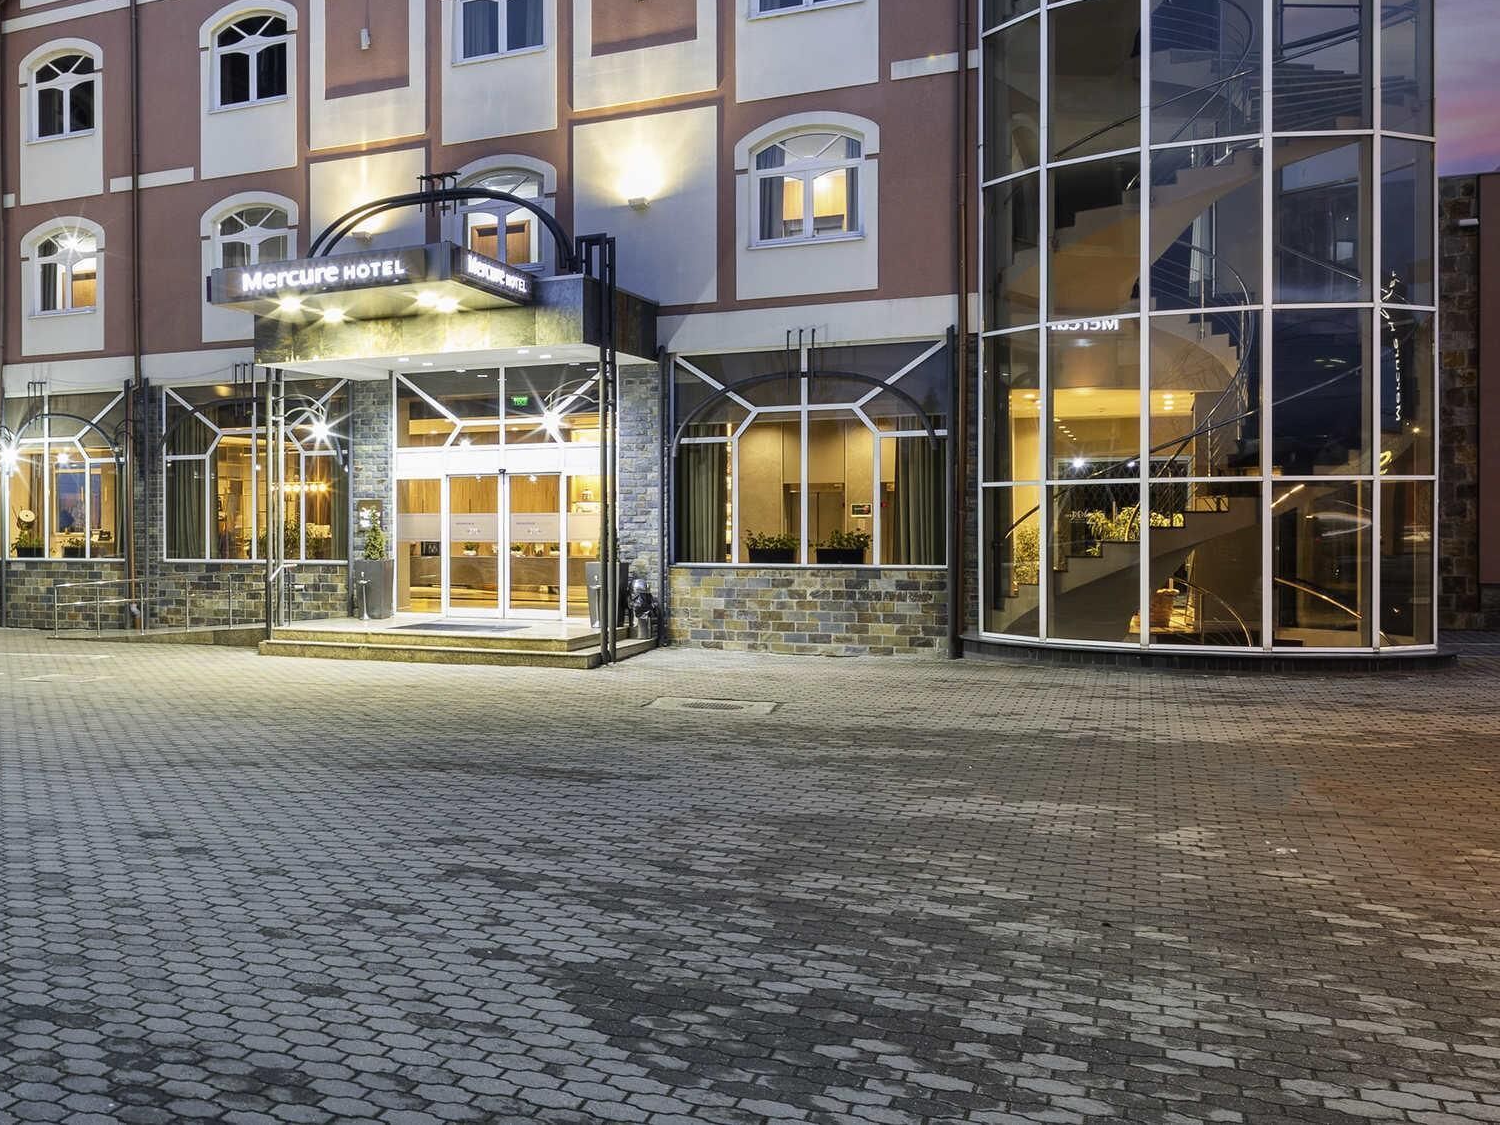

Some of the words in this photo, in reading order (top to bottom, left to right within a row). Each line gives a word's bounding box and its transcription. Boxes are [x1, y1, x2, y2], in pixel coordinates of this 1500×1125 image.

[241, 264, 340, 292] Mercure
[343, 259, 405, 280] HOTEL
[467, 254, 506, 285] Mercure
